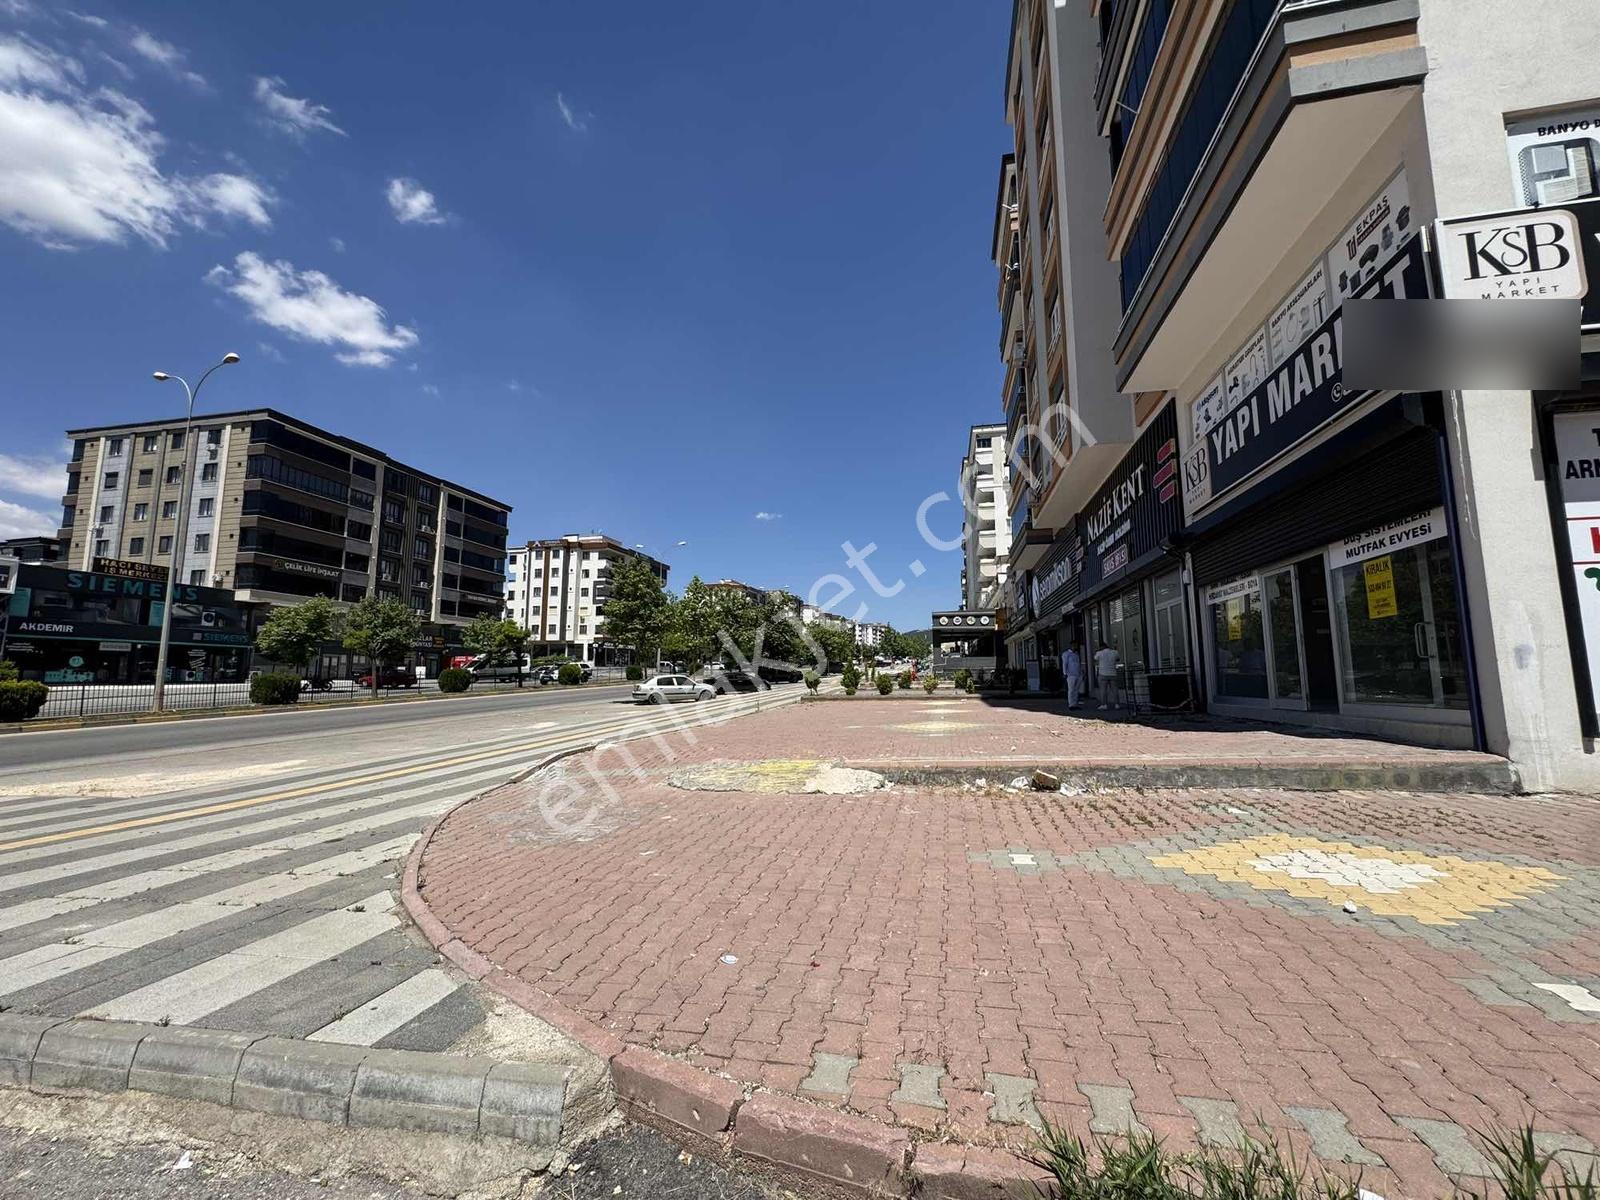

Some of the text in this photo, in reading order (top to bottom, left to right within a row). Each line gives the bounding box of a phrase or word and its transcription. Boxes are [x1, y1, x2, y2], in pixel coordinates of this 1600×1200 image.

[1537, 120, 1590, 137] BANYO
[1457, 222, 1571, 281] KSB
[1482, 284, 1560, 299] MARKET
[1495, 277, 1541, 288] YAPI
[1211, 254, 1411, 466] YAPI MART
[1112, 463, 1144, 521] KENT
[1345, 522, 1433, 559] MUTFAK EVYESİ
[67, 573, 198, 601] SIEMENS
